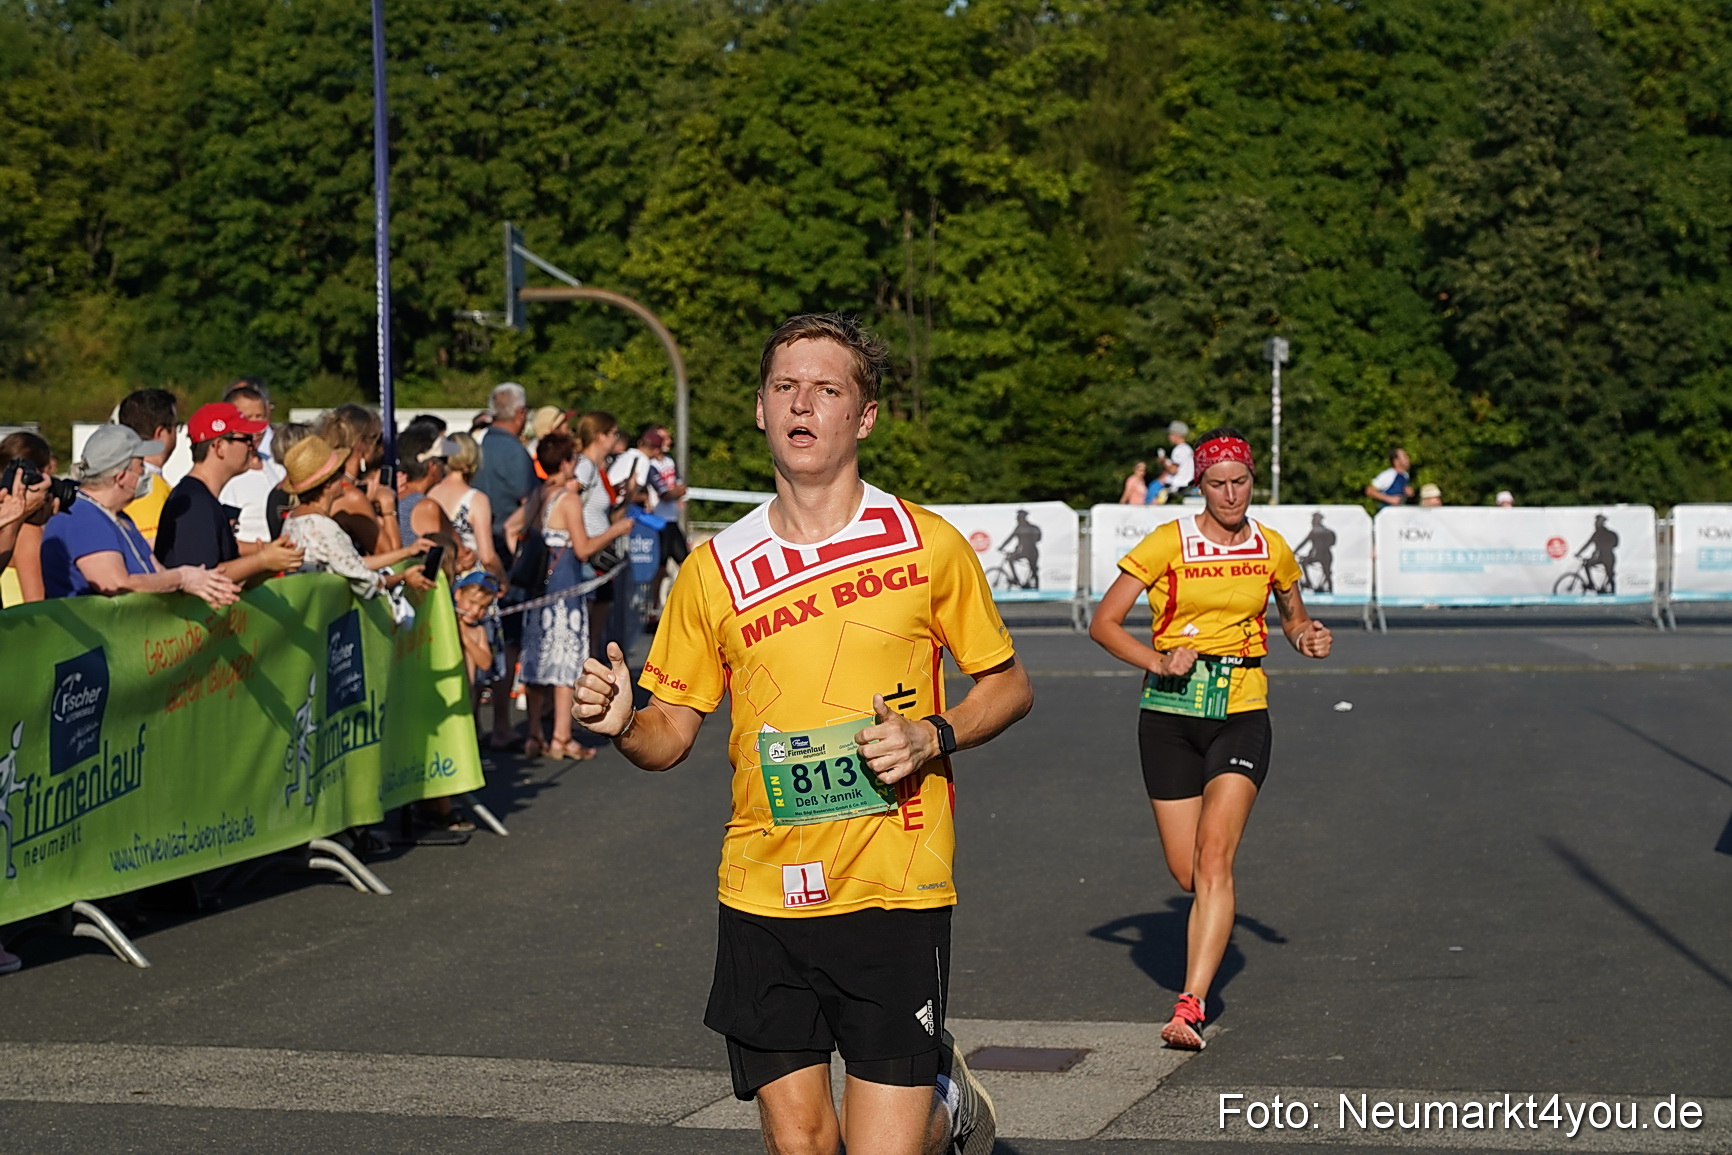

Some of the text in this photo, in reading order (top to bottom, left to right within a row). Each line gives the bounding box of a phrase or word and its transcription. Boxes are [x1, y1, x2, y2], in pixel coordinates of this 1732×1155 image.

[1184, 562, 1268, 579] MAX BÖGL
[740, 563, 929, 649] MAX BÖGL
[61, 686, 102, 715] Fischer
[1194, 683, 1204, 709] 2022
[787, 744, 826, 757] Firmenlauf
[24, 723, 146, 838] firmenlauf
[770, 776, 785, 808] RUN
[795, 788, 863, 808] Deß Yannik
[24, 823, 82, 867] neumarkt
